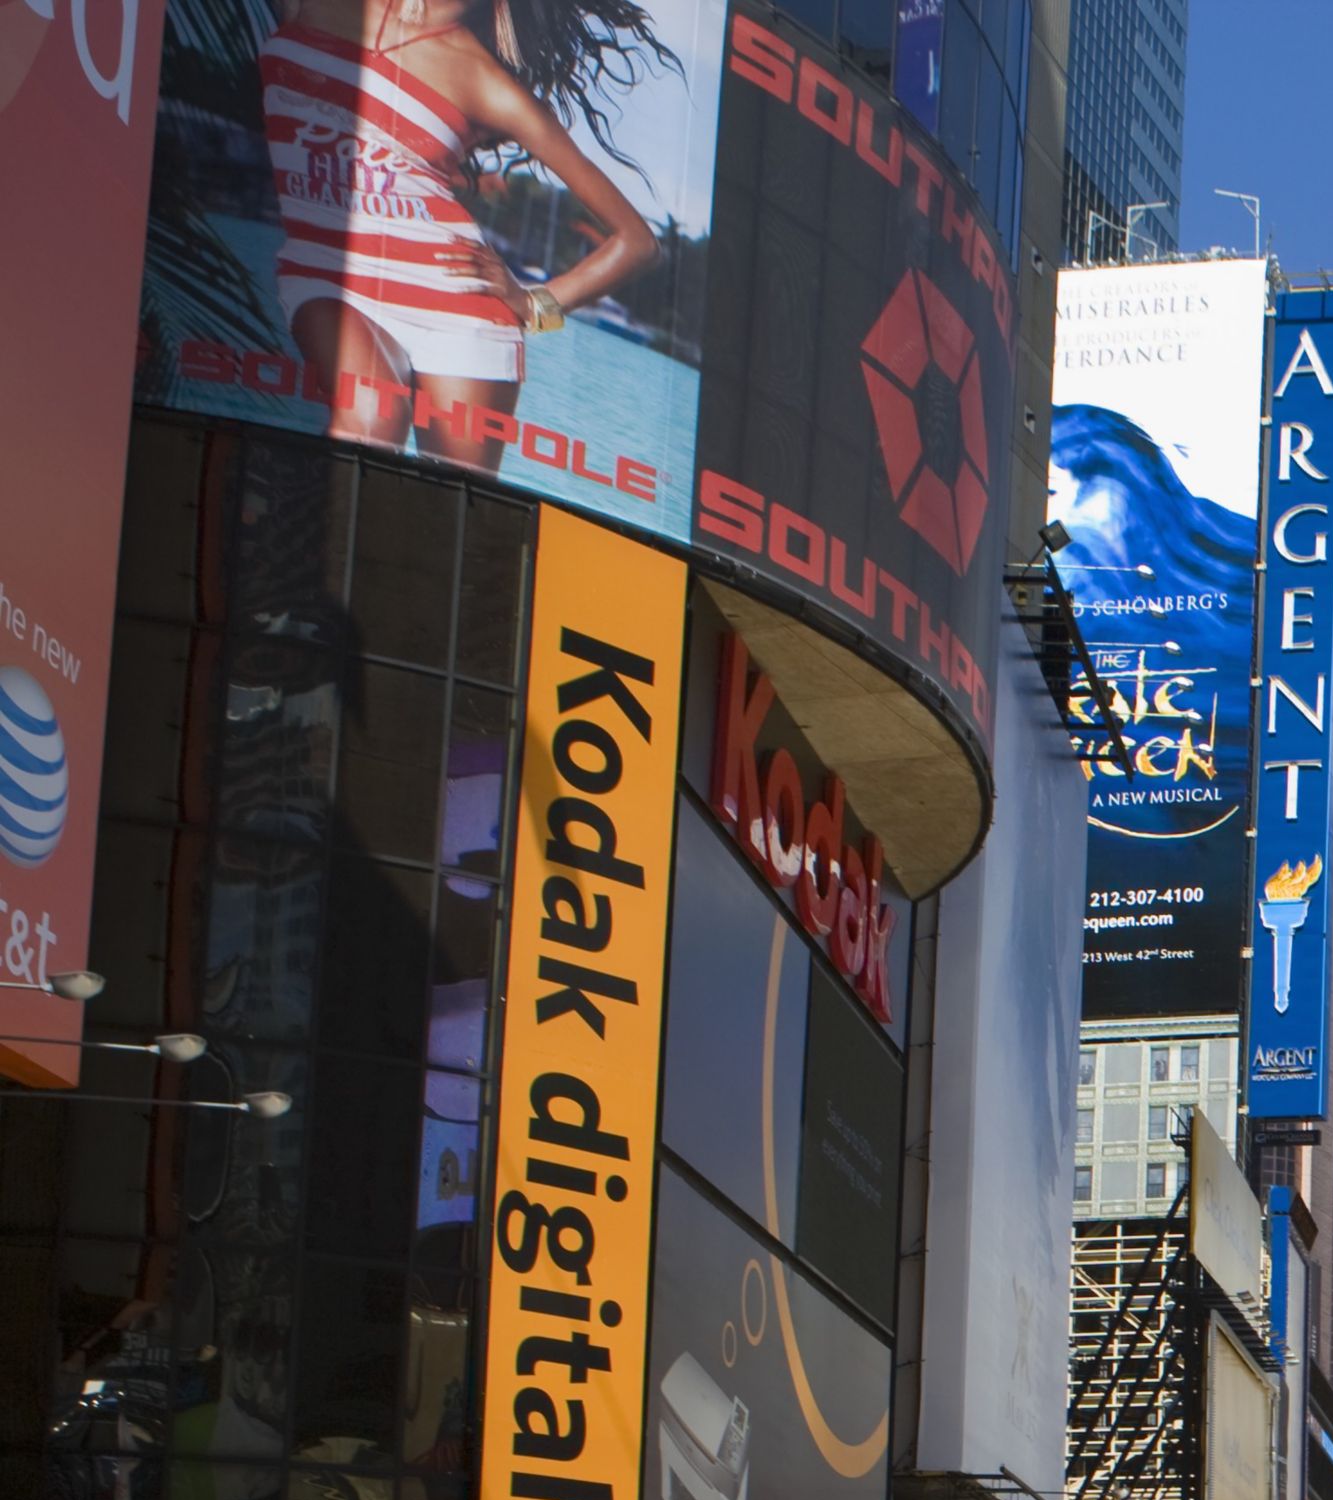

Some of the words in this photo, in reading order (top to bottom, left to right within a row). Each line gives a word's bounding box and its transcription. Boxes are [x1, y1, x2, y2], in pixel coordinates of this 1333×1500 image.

[285, 170, 434, 224] GLAMOUR
[1056, 295, 1211, 320] MISERABLES
[181, 340, 657, 503] SOUTHPOLE
[32, 618, 82, 685] new
[1092, 793, 1104, 807] A
[1108, 790, 1146, 806] NEW
[1150, 787, 1222, 804] MUSICAL
[535, 626, 655, 1041] Kodak
[709, 629, 895, 1024] Kodak
[1090, 886, 1205, 907] 212-307-4100
[1105, 951, 1133, 962] West
[1160, 948, 1195, 960] Street
[1252, 1045, 1317, 1068] ARGENT
